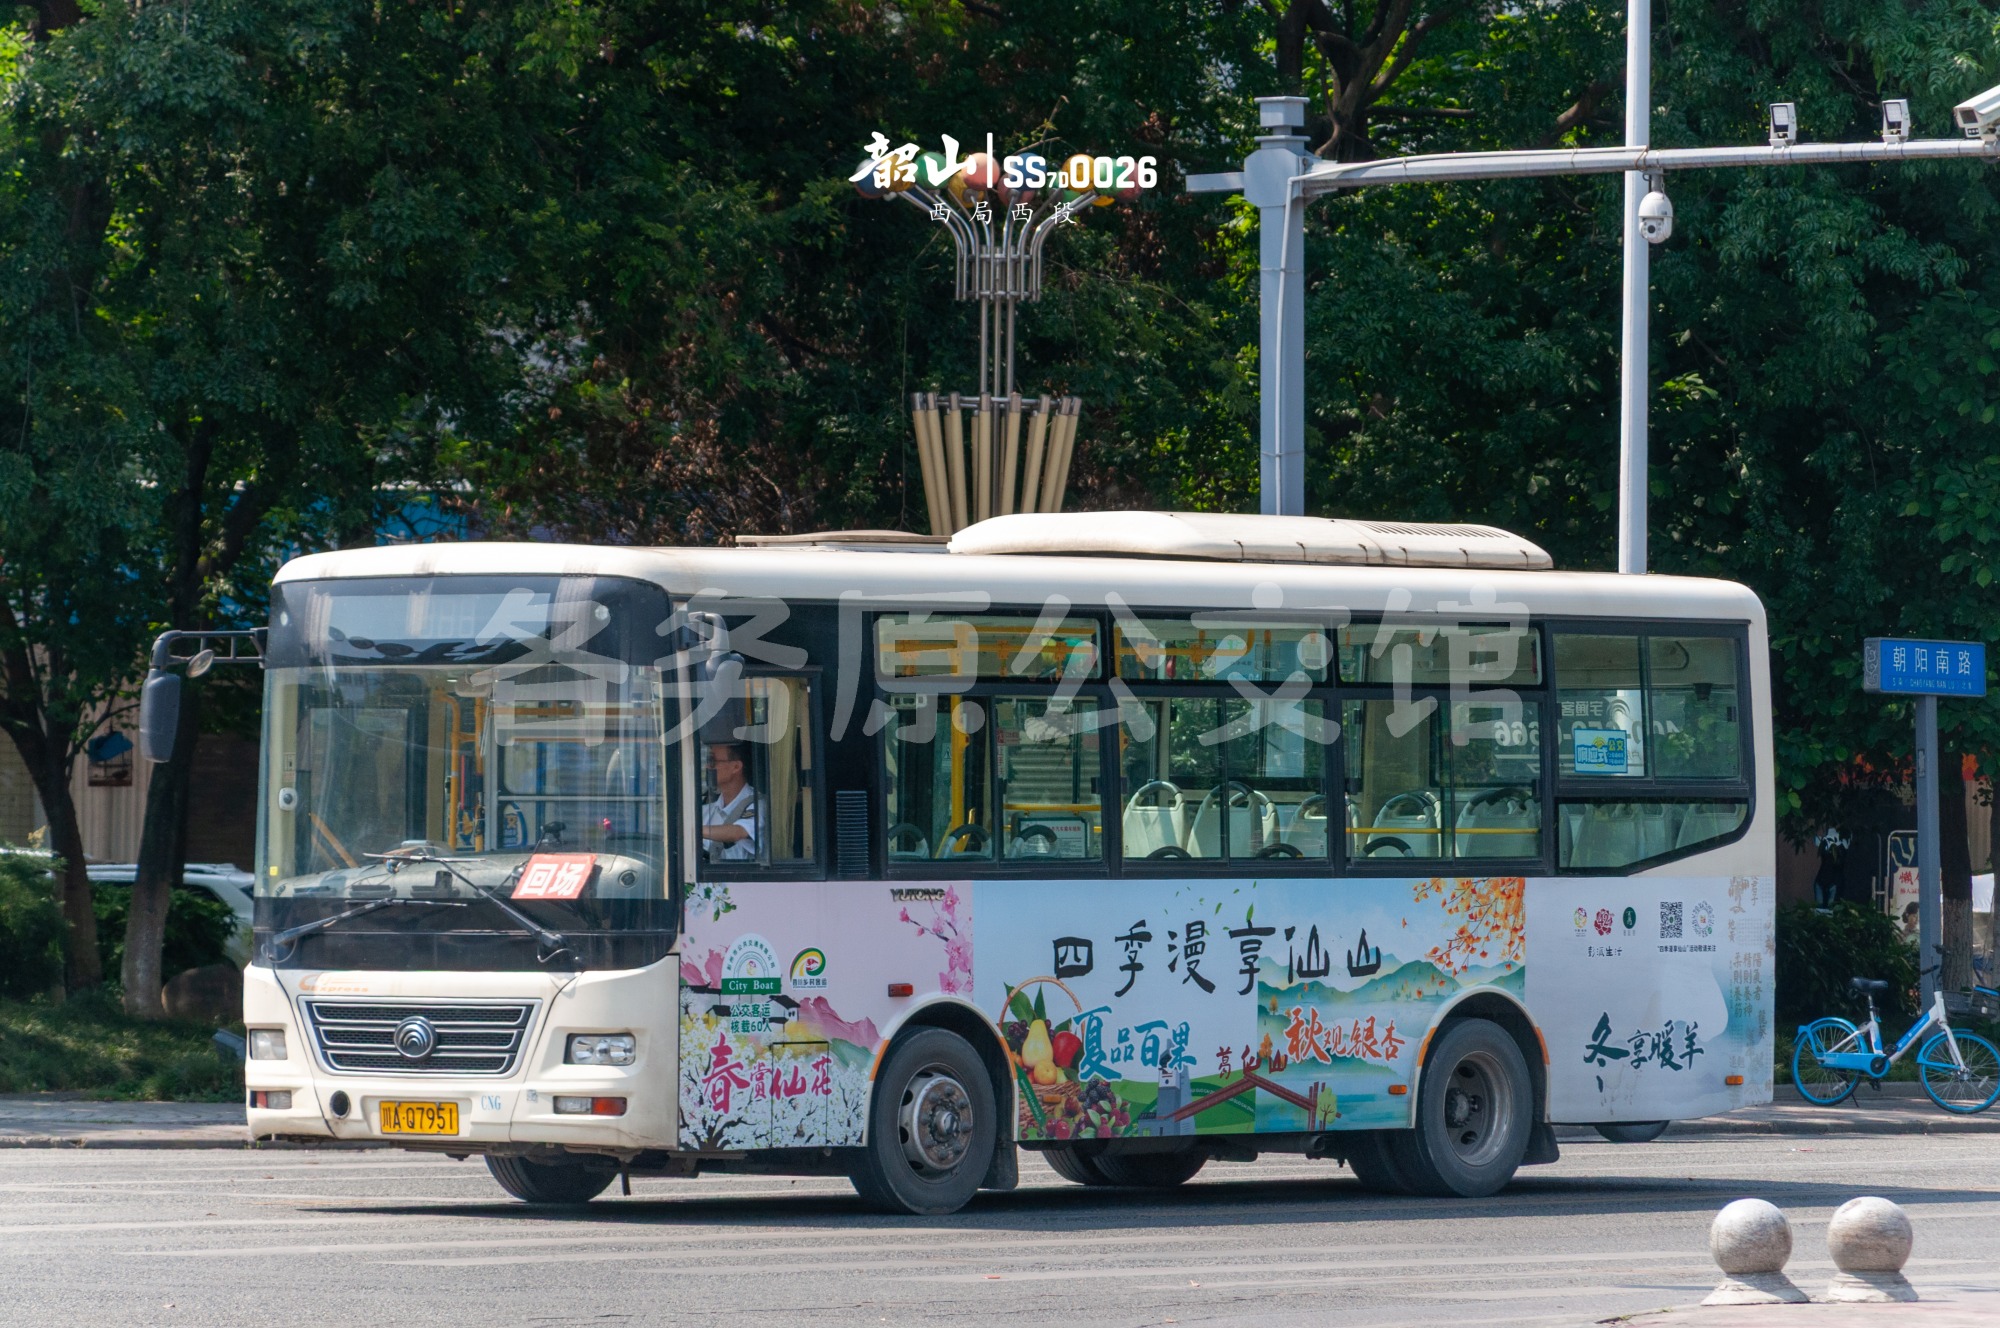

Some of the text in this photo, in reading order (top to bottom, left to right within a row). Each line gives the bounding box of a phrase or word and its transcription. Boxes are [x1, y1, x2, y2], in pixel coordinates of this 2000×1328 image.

[1893, 646, 1971, 675] 朝阳南路
[520, 862, 586, 897] 回场
[890, 888, 946, 902] YUTONG
[1052, 919, 1383, 997] 四季漫享仙山
[728, 980, 774, 992] City Boat
[731, 1003, 771, 1017] 公交客运
[731, 1019, 772, 1033] 核载60人
[1072, 1005, 1197, 1082] 夏品百果
[1284, 1008, 1405, 1064] 秋观银杏
[1216, 1045, 1287, 1080] 葛仙山
[1584, 1012, 1704, 1093] 冬享暖羊
[481, 1095, 502, 1110] CNG
